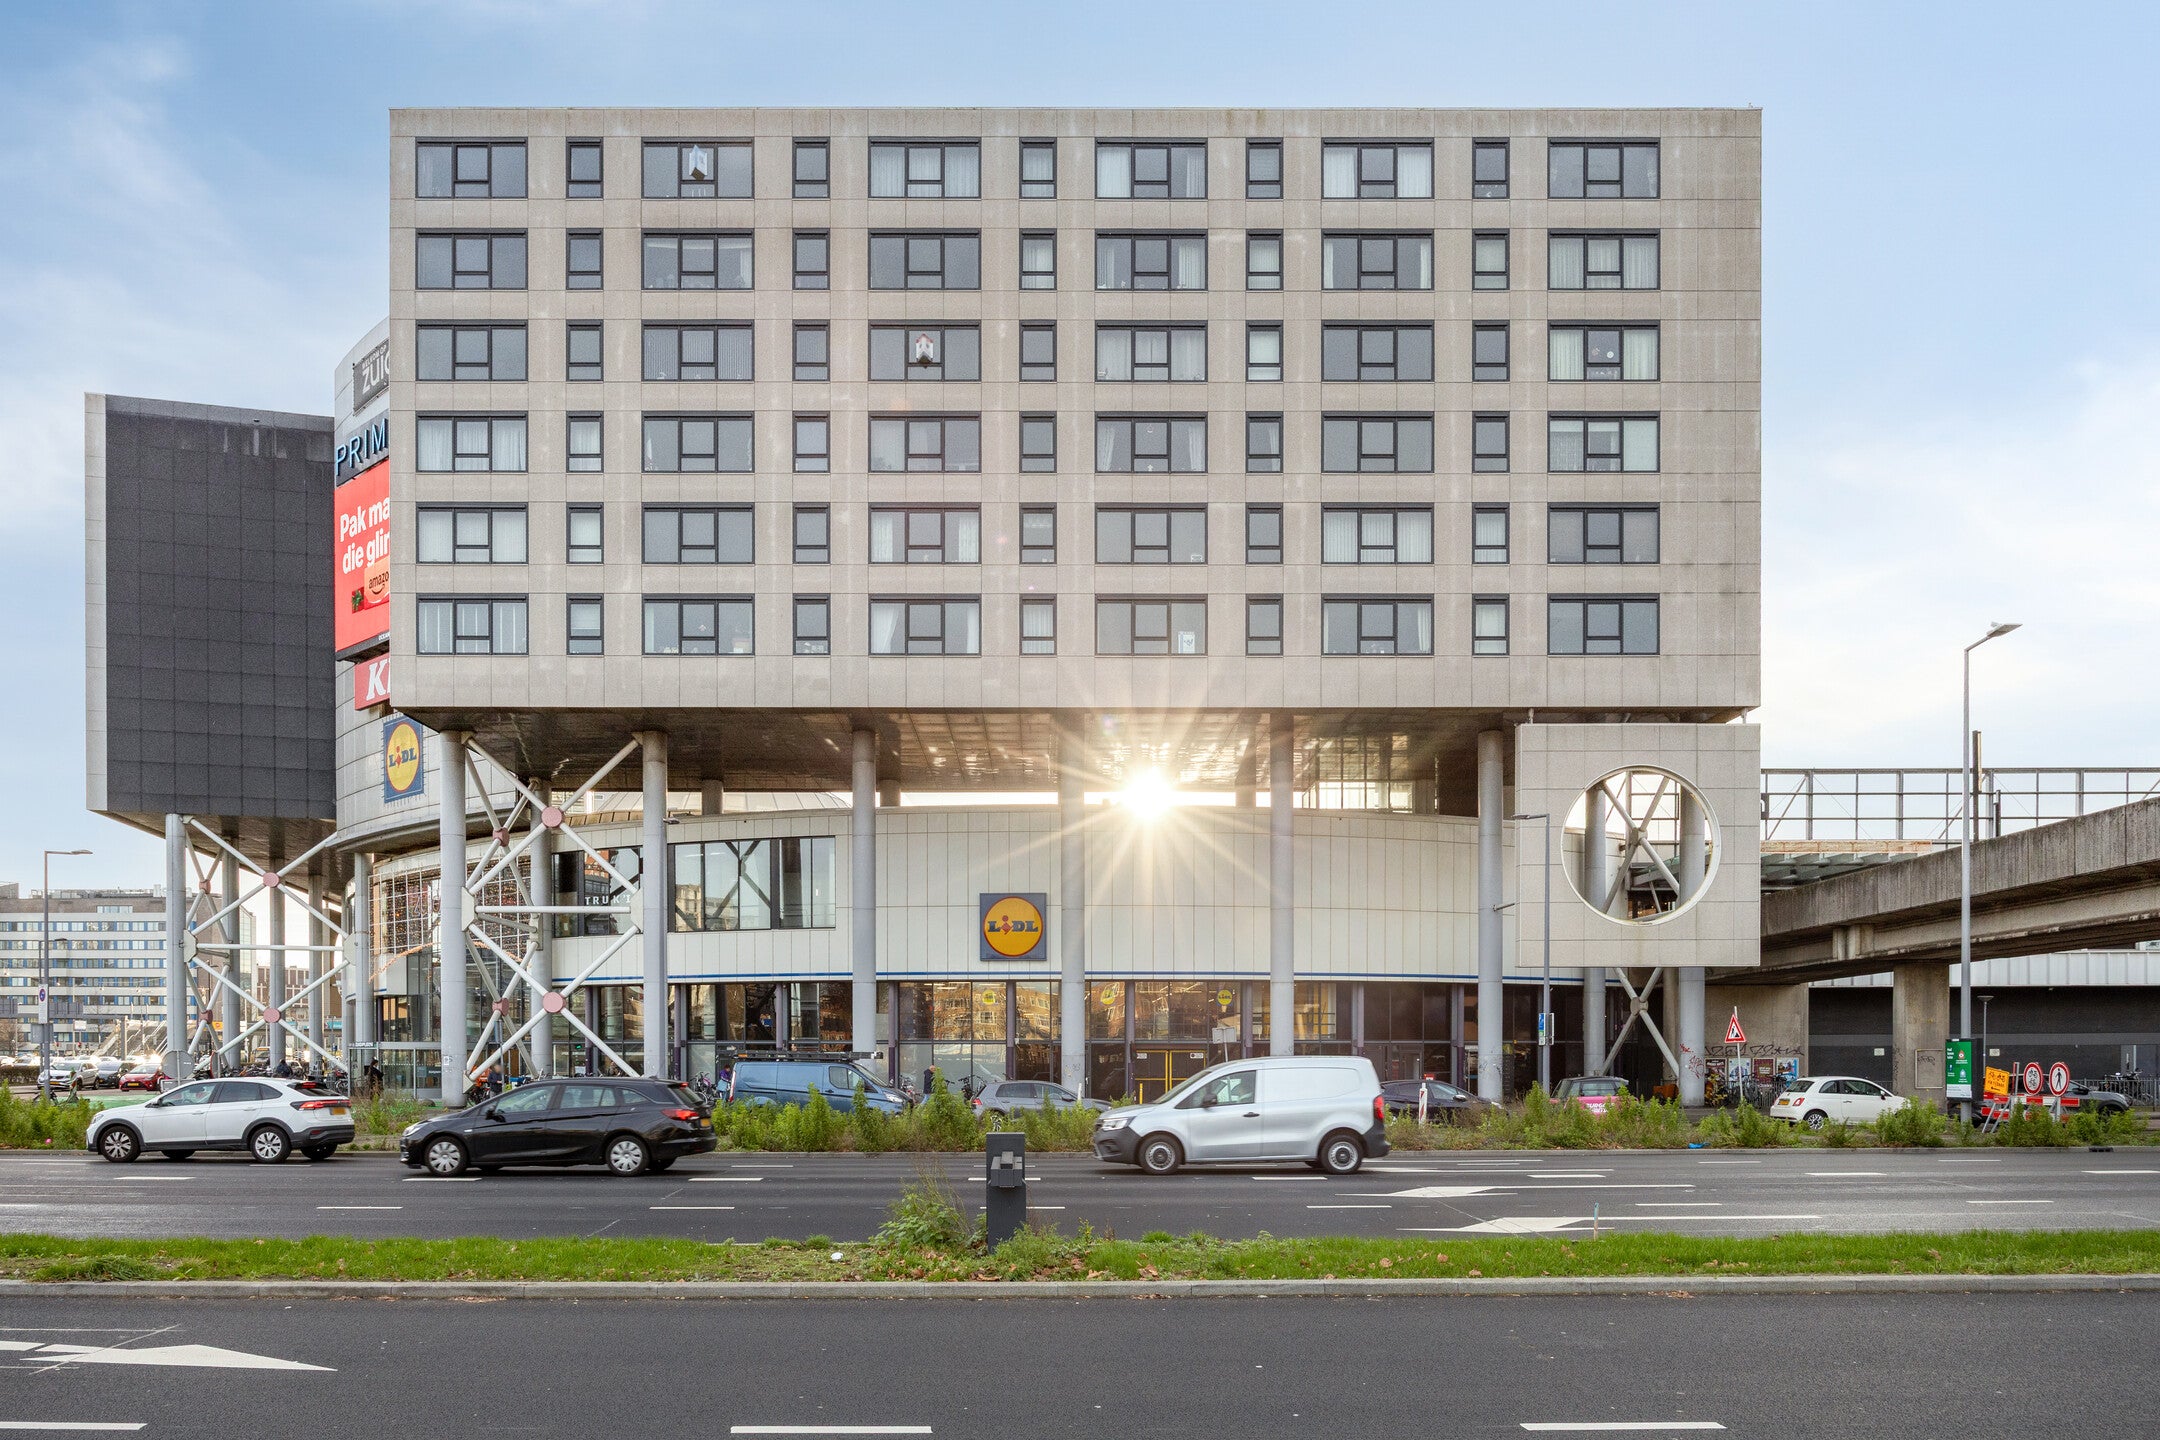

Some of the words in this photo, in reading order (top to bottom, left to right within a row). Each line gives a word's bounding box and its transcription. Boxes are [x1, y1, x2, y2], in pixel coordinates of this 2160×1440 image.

[340, 506, 366, 543] Pak
[342, 542, 364, 575] die
[366, 658, 390, 701] K
